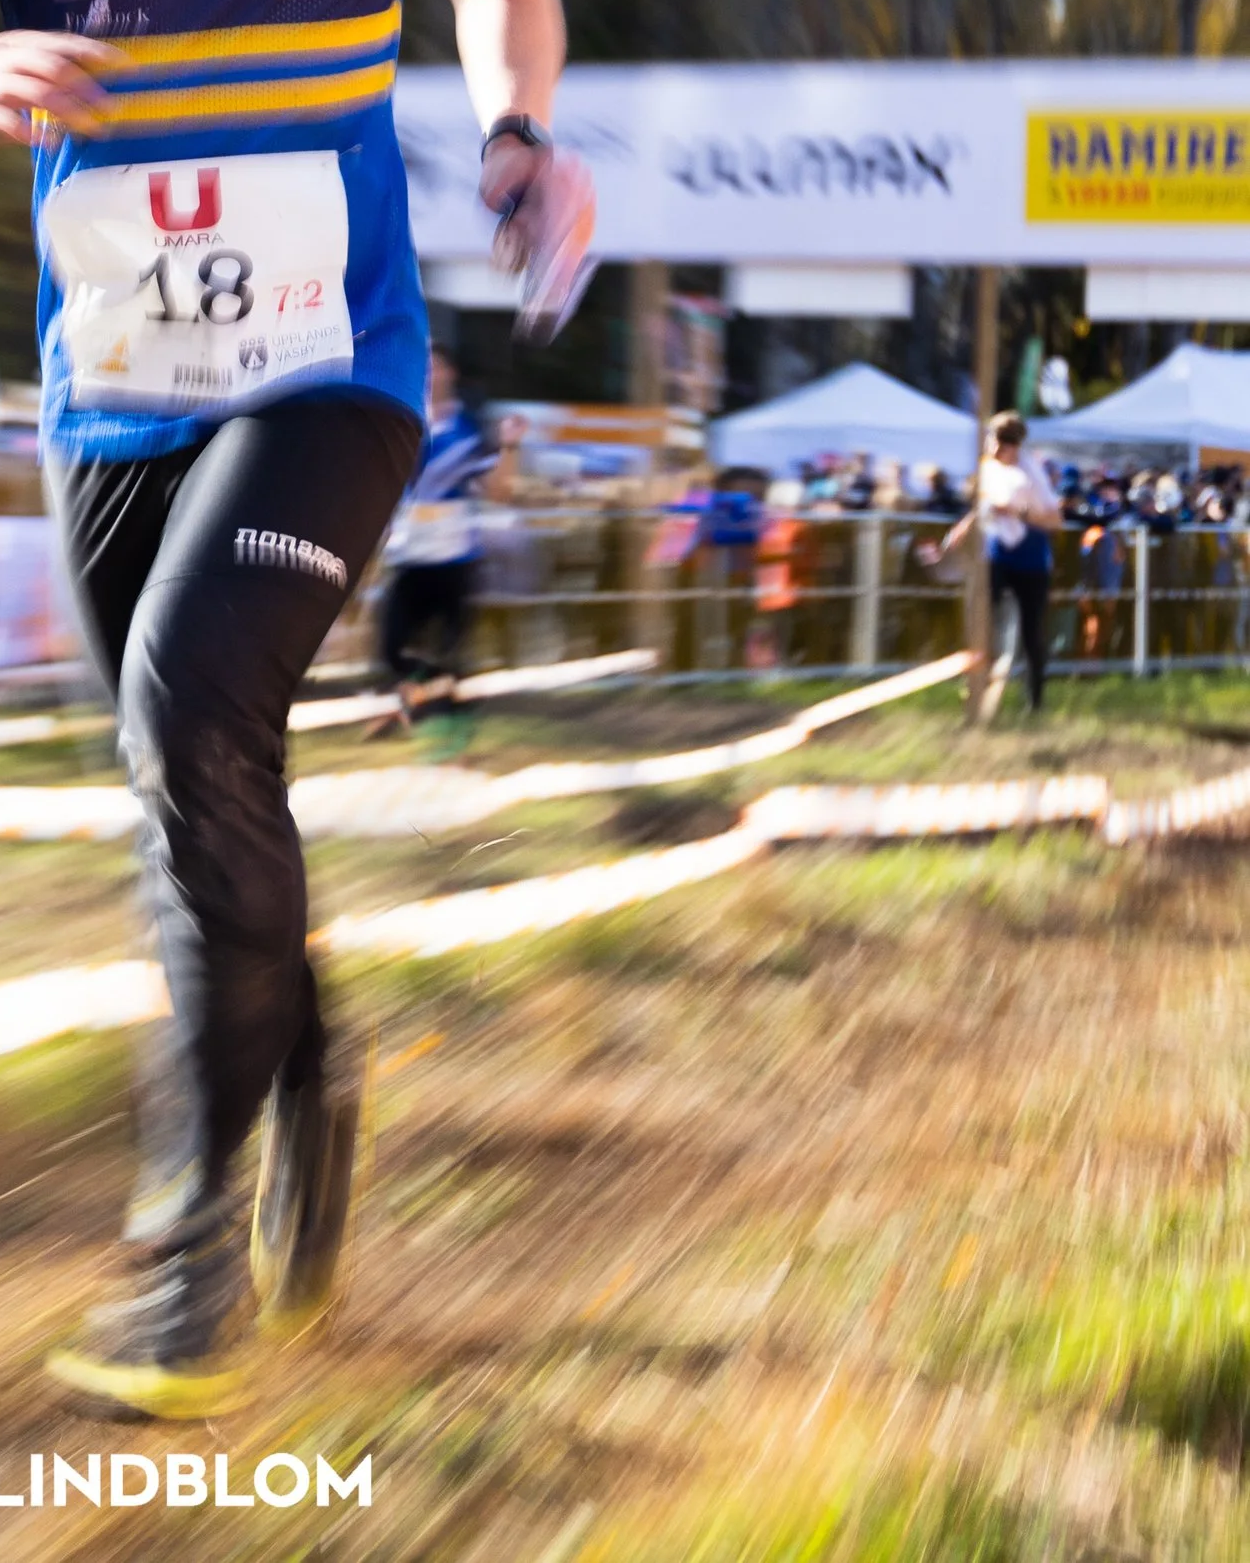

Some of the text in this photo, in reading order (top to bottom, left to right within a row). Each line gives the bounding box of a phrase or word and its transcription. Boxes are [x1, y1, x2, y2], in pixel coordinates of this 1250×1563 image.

[154, 232, 225, 248] UMARA
[139, 248, 255, 326] 18
[272, 279, 325, 315] 7:2
[271, 324, 341, 347] UPPLANDS
